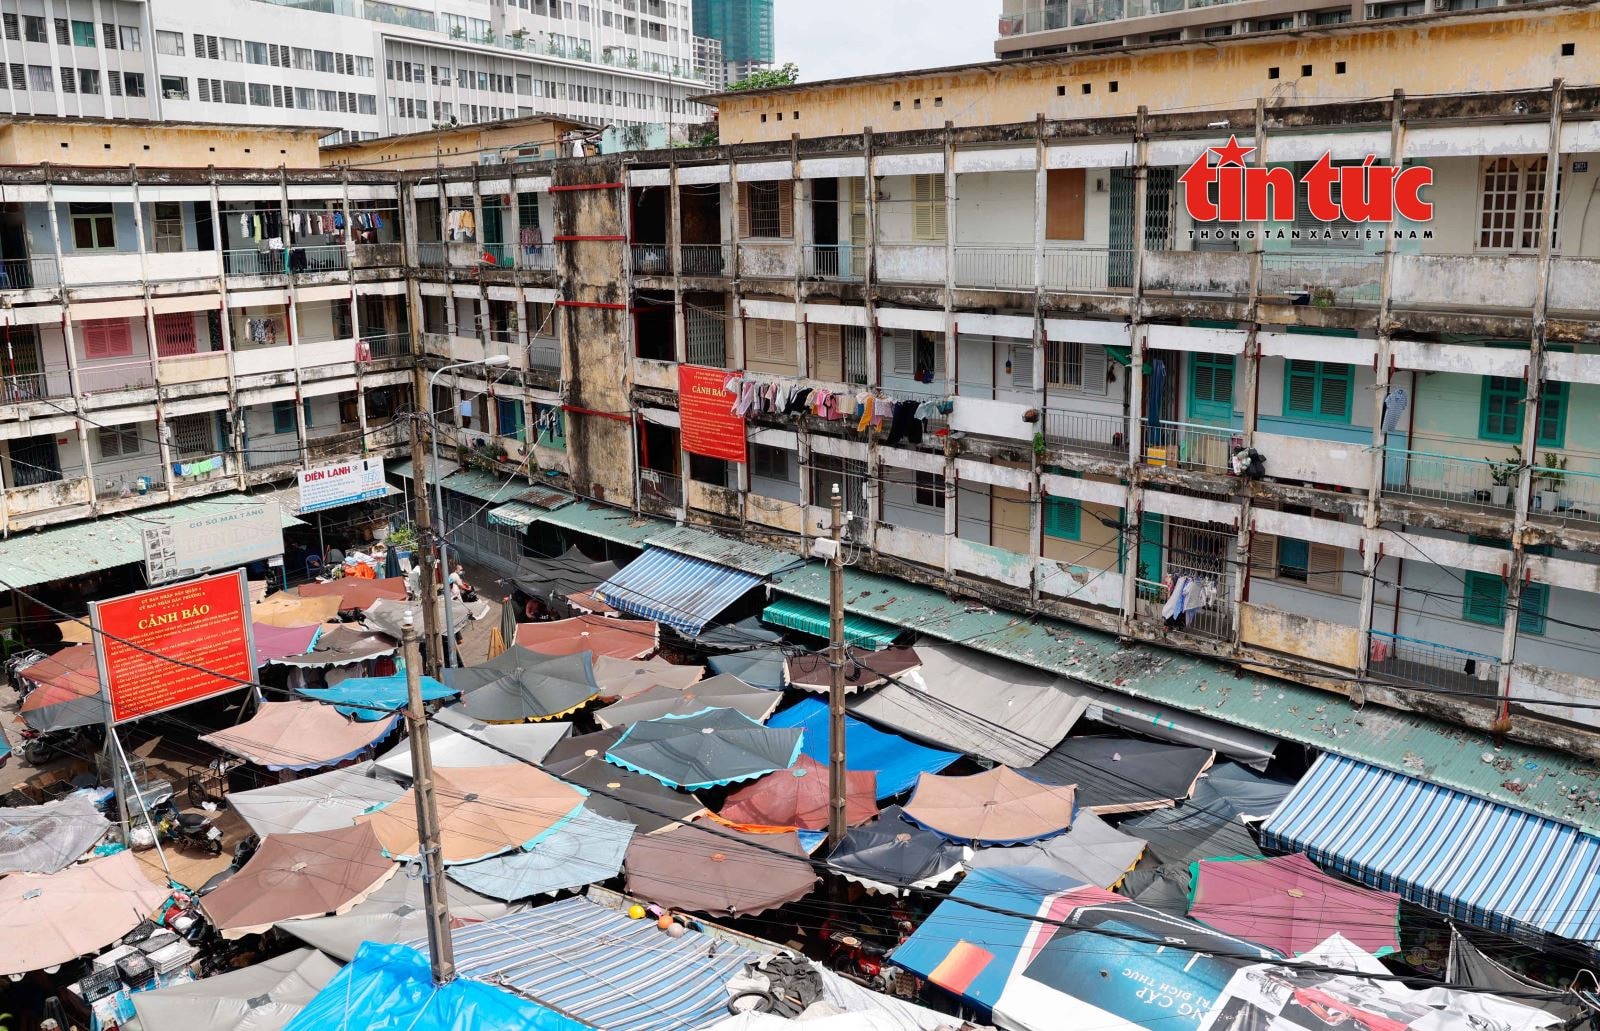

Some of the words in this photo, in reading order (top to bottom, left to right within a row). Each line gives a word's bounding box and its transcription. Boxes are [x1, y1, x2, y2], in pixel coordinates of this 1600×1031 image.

[138, 613, 178, 630] CẢNH
[181, 604, 210, 620] BÁO
[1135, 986, 1174, 1008] CẤP
